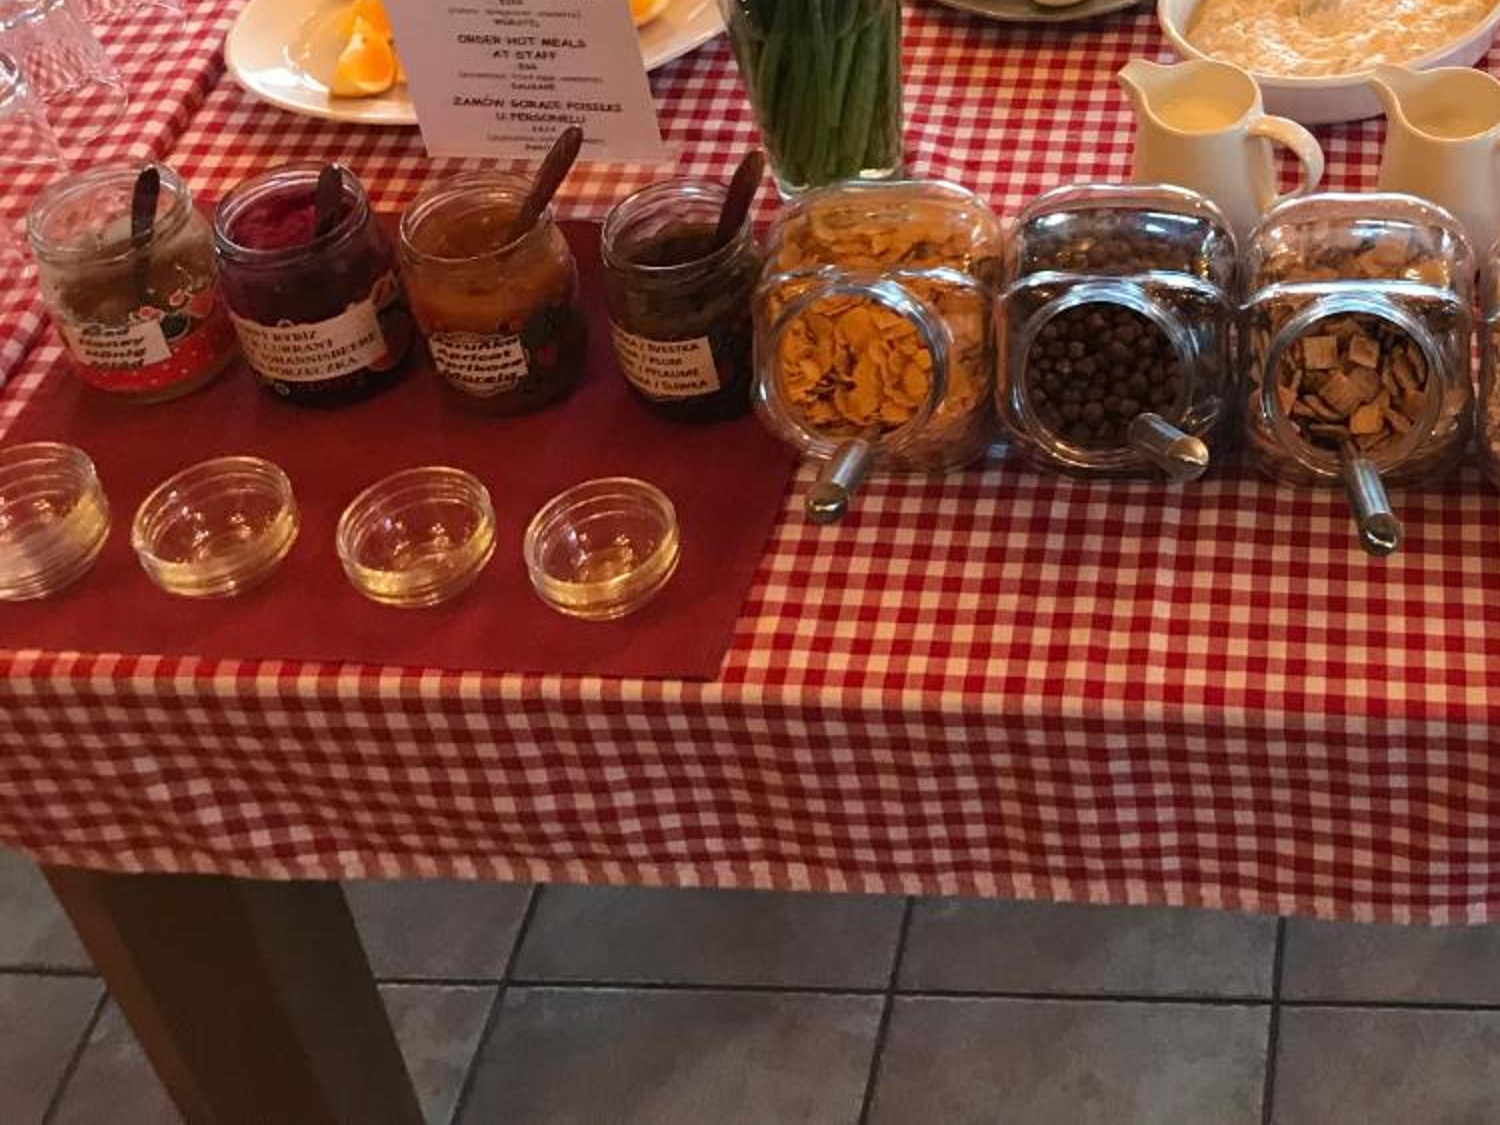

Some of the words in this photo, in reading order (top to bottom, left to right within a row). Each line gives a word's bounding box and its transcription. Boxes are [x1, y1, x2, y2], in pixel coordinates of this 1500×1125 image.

[506, 35, 538, 46] HOT
[541, 36, 587, 49] MEALS
[493, 49, 512, 59] AT
